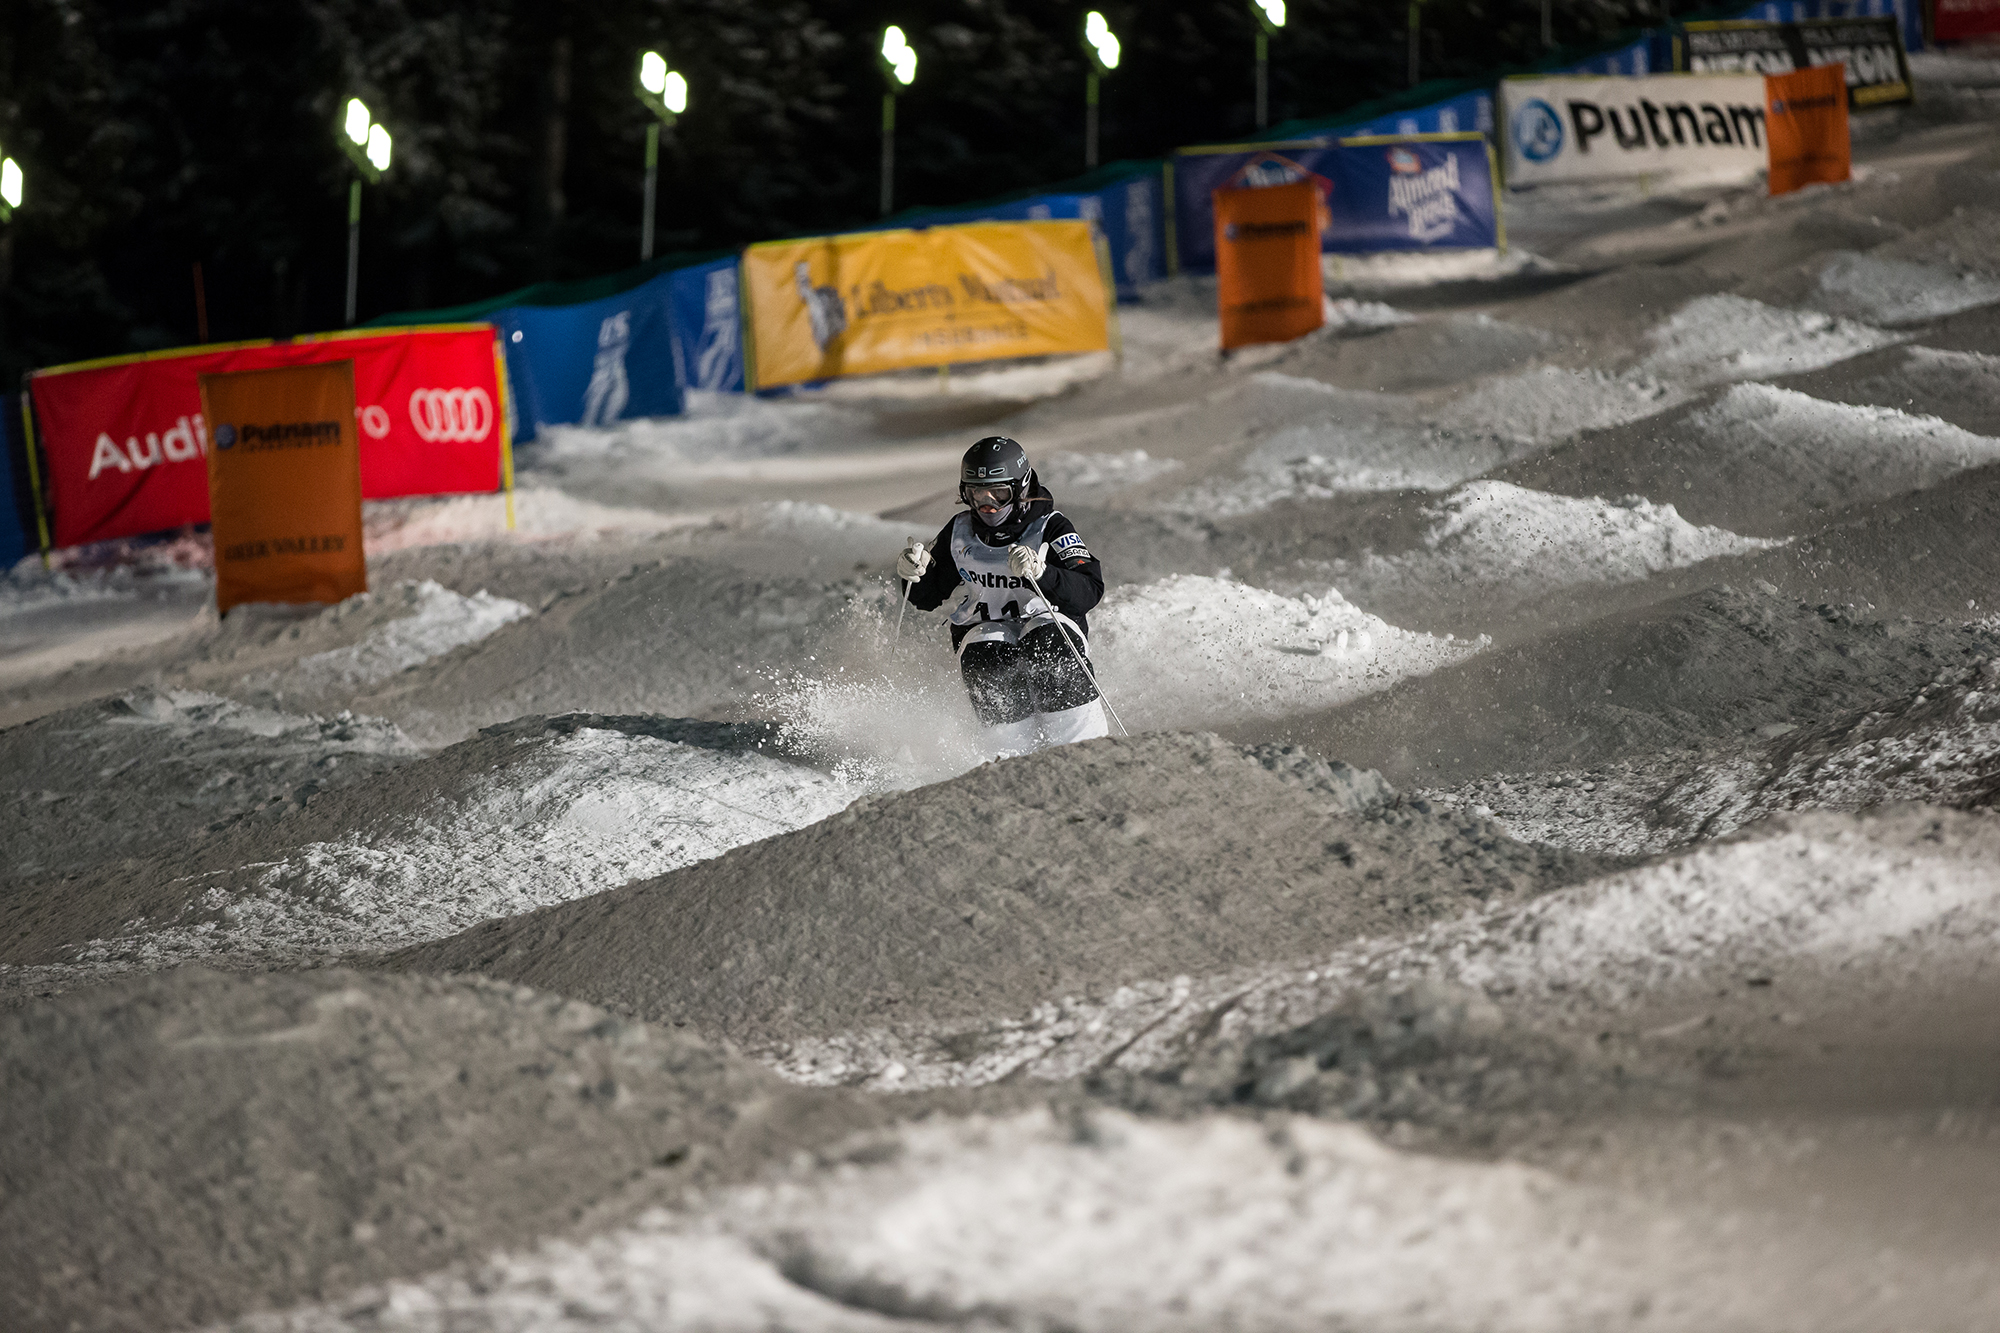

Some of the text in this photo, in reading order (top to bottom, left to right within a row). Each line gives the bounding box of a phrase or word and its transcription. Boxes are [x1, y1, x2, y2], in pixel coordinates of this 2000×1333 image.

[1567, 98, 1765, 153] Putnam
[88, 414, 206, 480] Audi
[242, 421, 342, 443] Putnam
[1054, 534, 1083, 549] VISA
